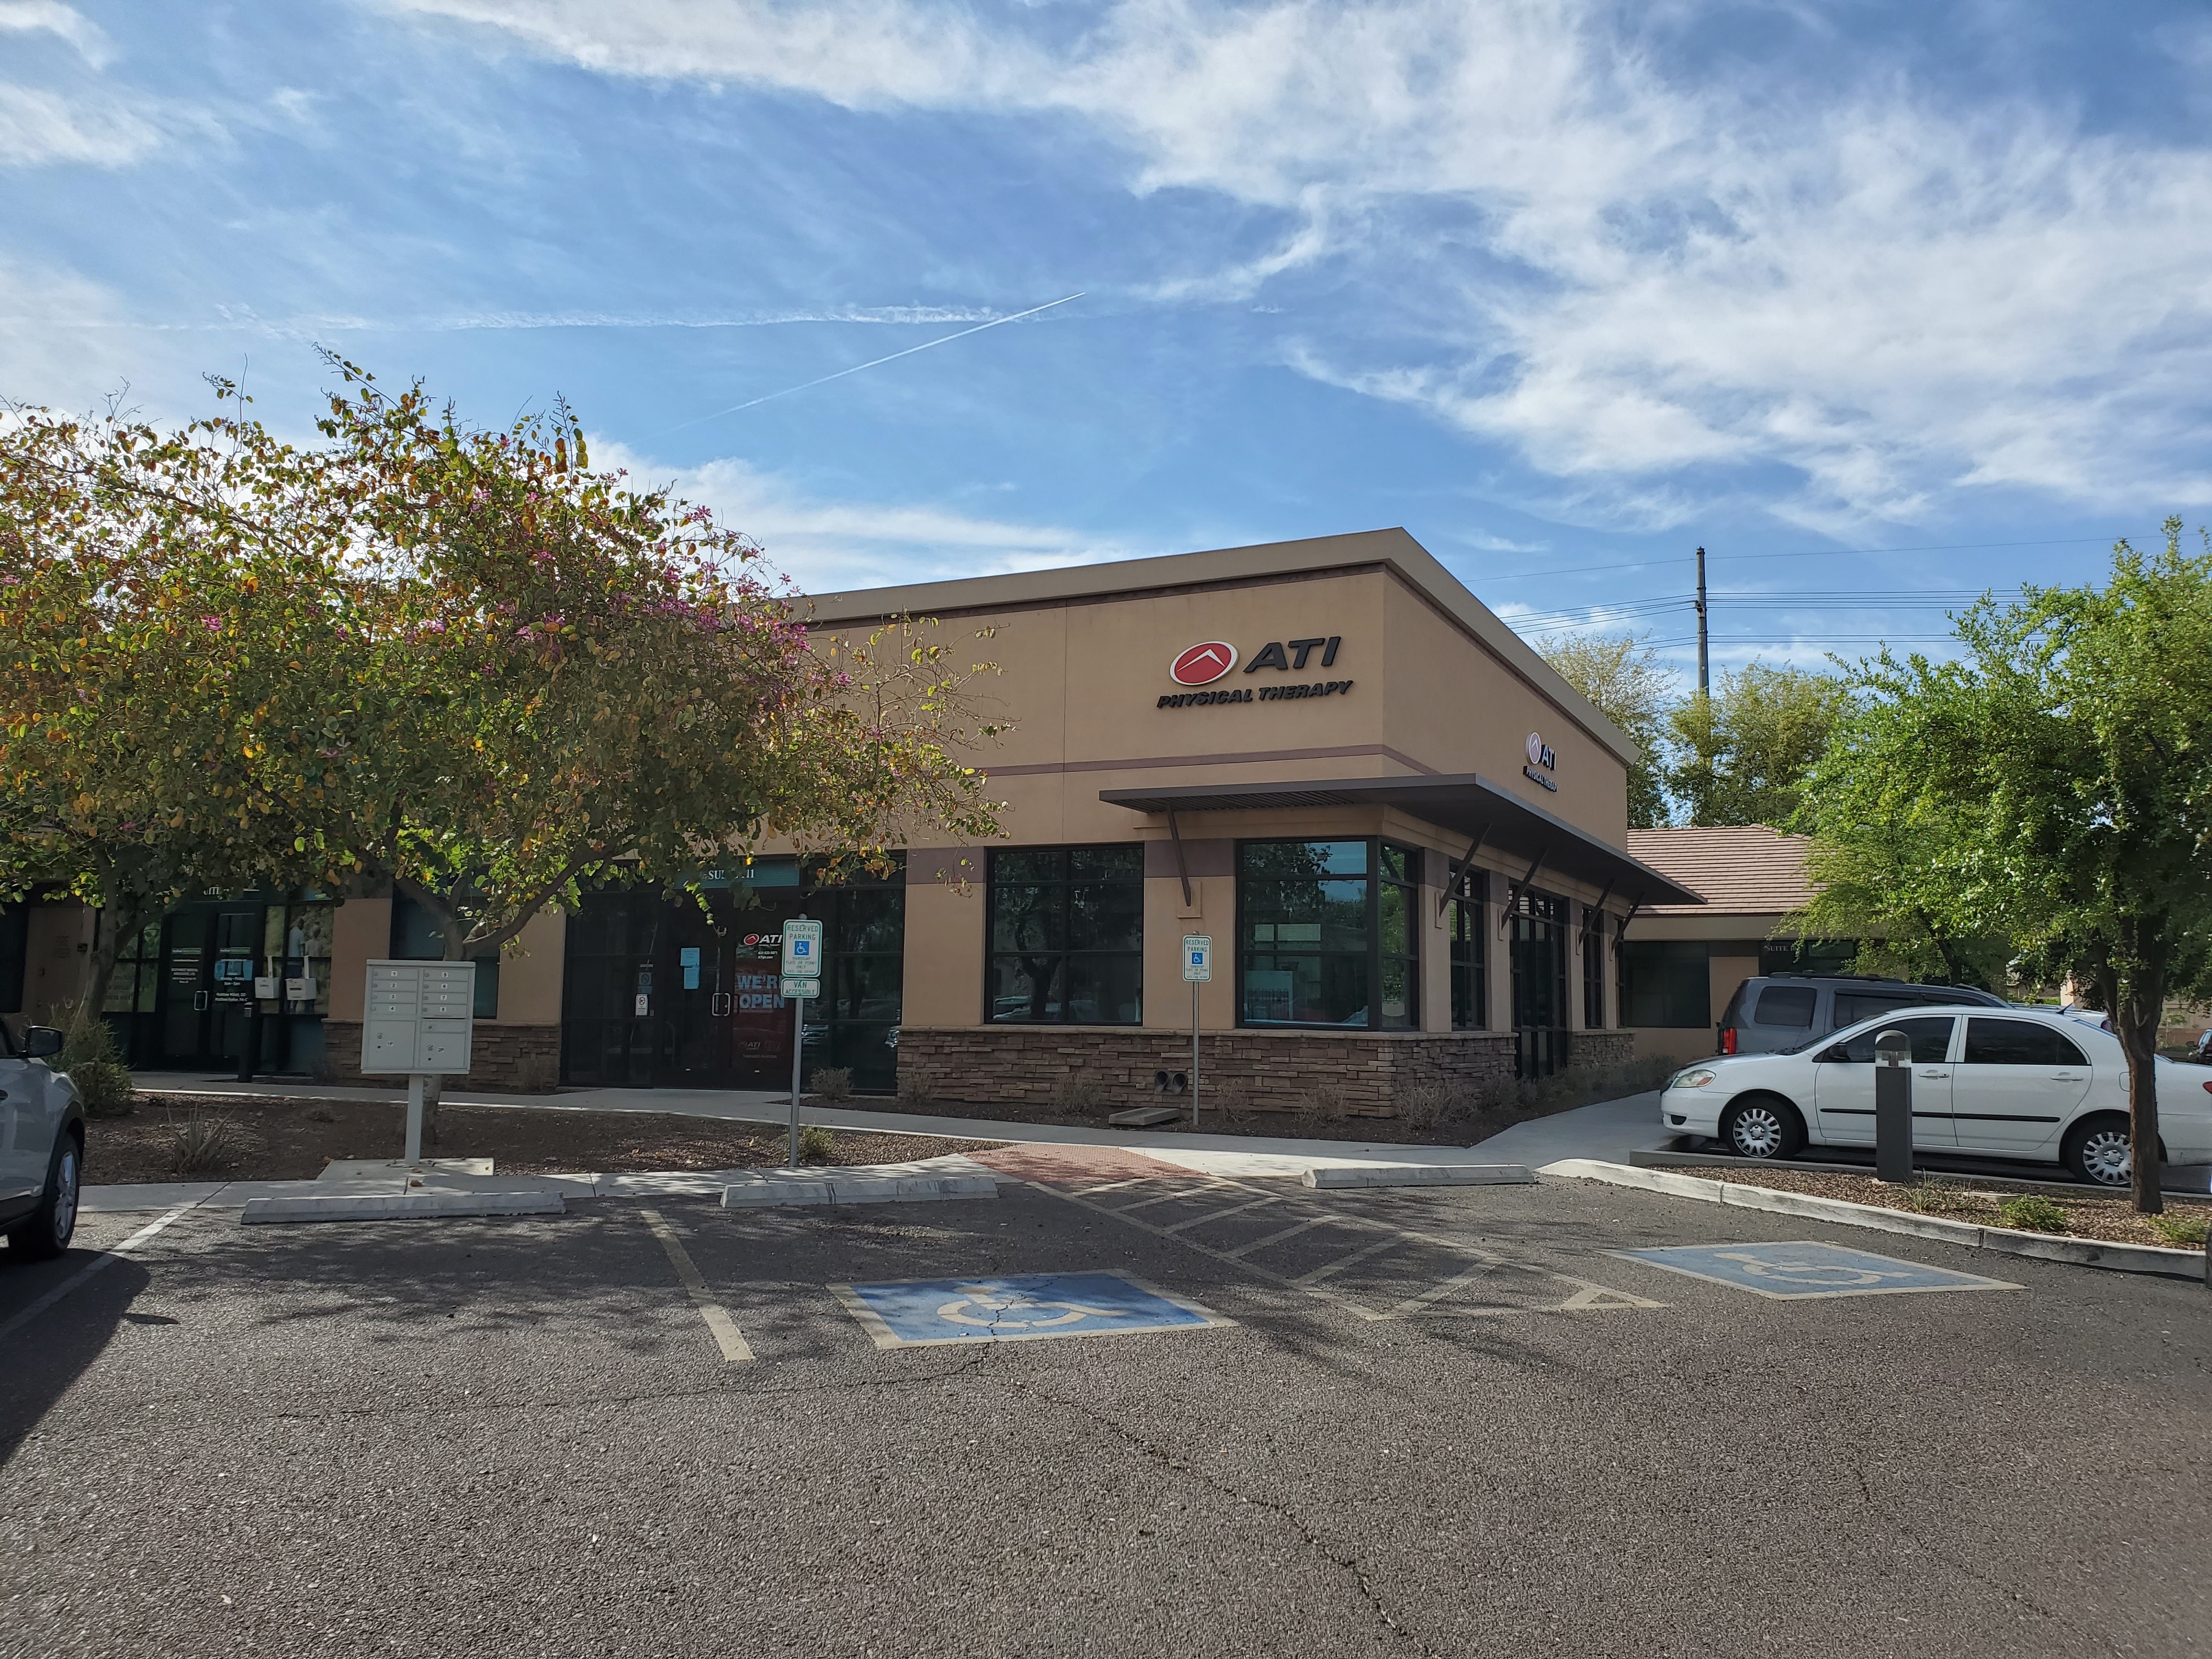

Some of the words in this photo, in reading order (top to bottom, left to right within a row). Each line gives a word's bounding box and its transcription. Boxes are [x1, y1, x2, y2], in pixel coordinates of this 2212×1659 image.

[1243, 636, 1341, 673] ATI
[1156, 689, 1253, 708] PHYSICAL
[1259, 680, 1353, 700] THERAPY
[1541, 744, 1556, 771] ATI
[1526, 766, 1543, 784] PHYSICAL
[1543, 776, 1558, 792] THERAPY
[758, 934, 783, 944] ATI
[737, 974, 782, 989] WE'R
[739, 994, 785, 1008] OPEN
